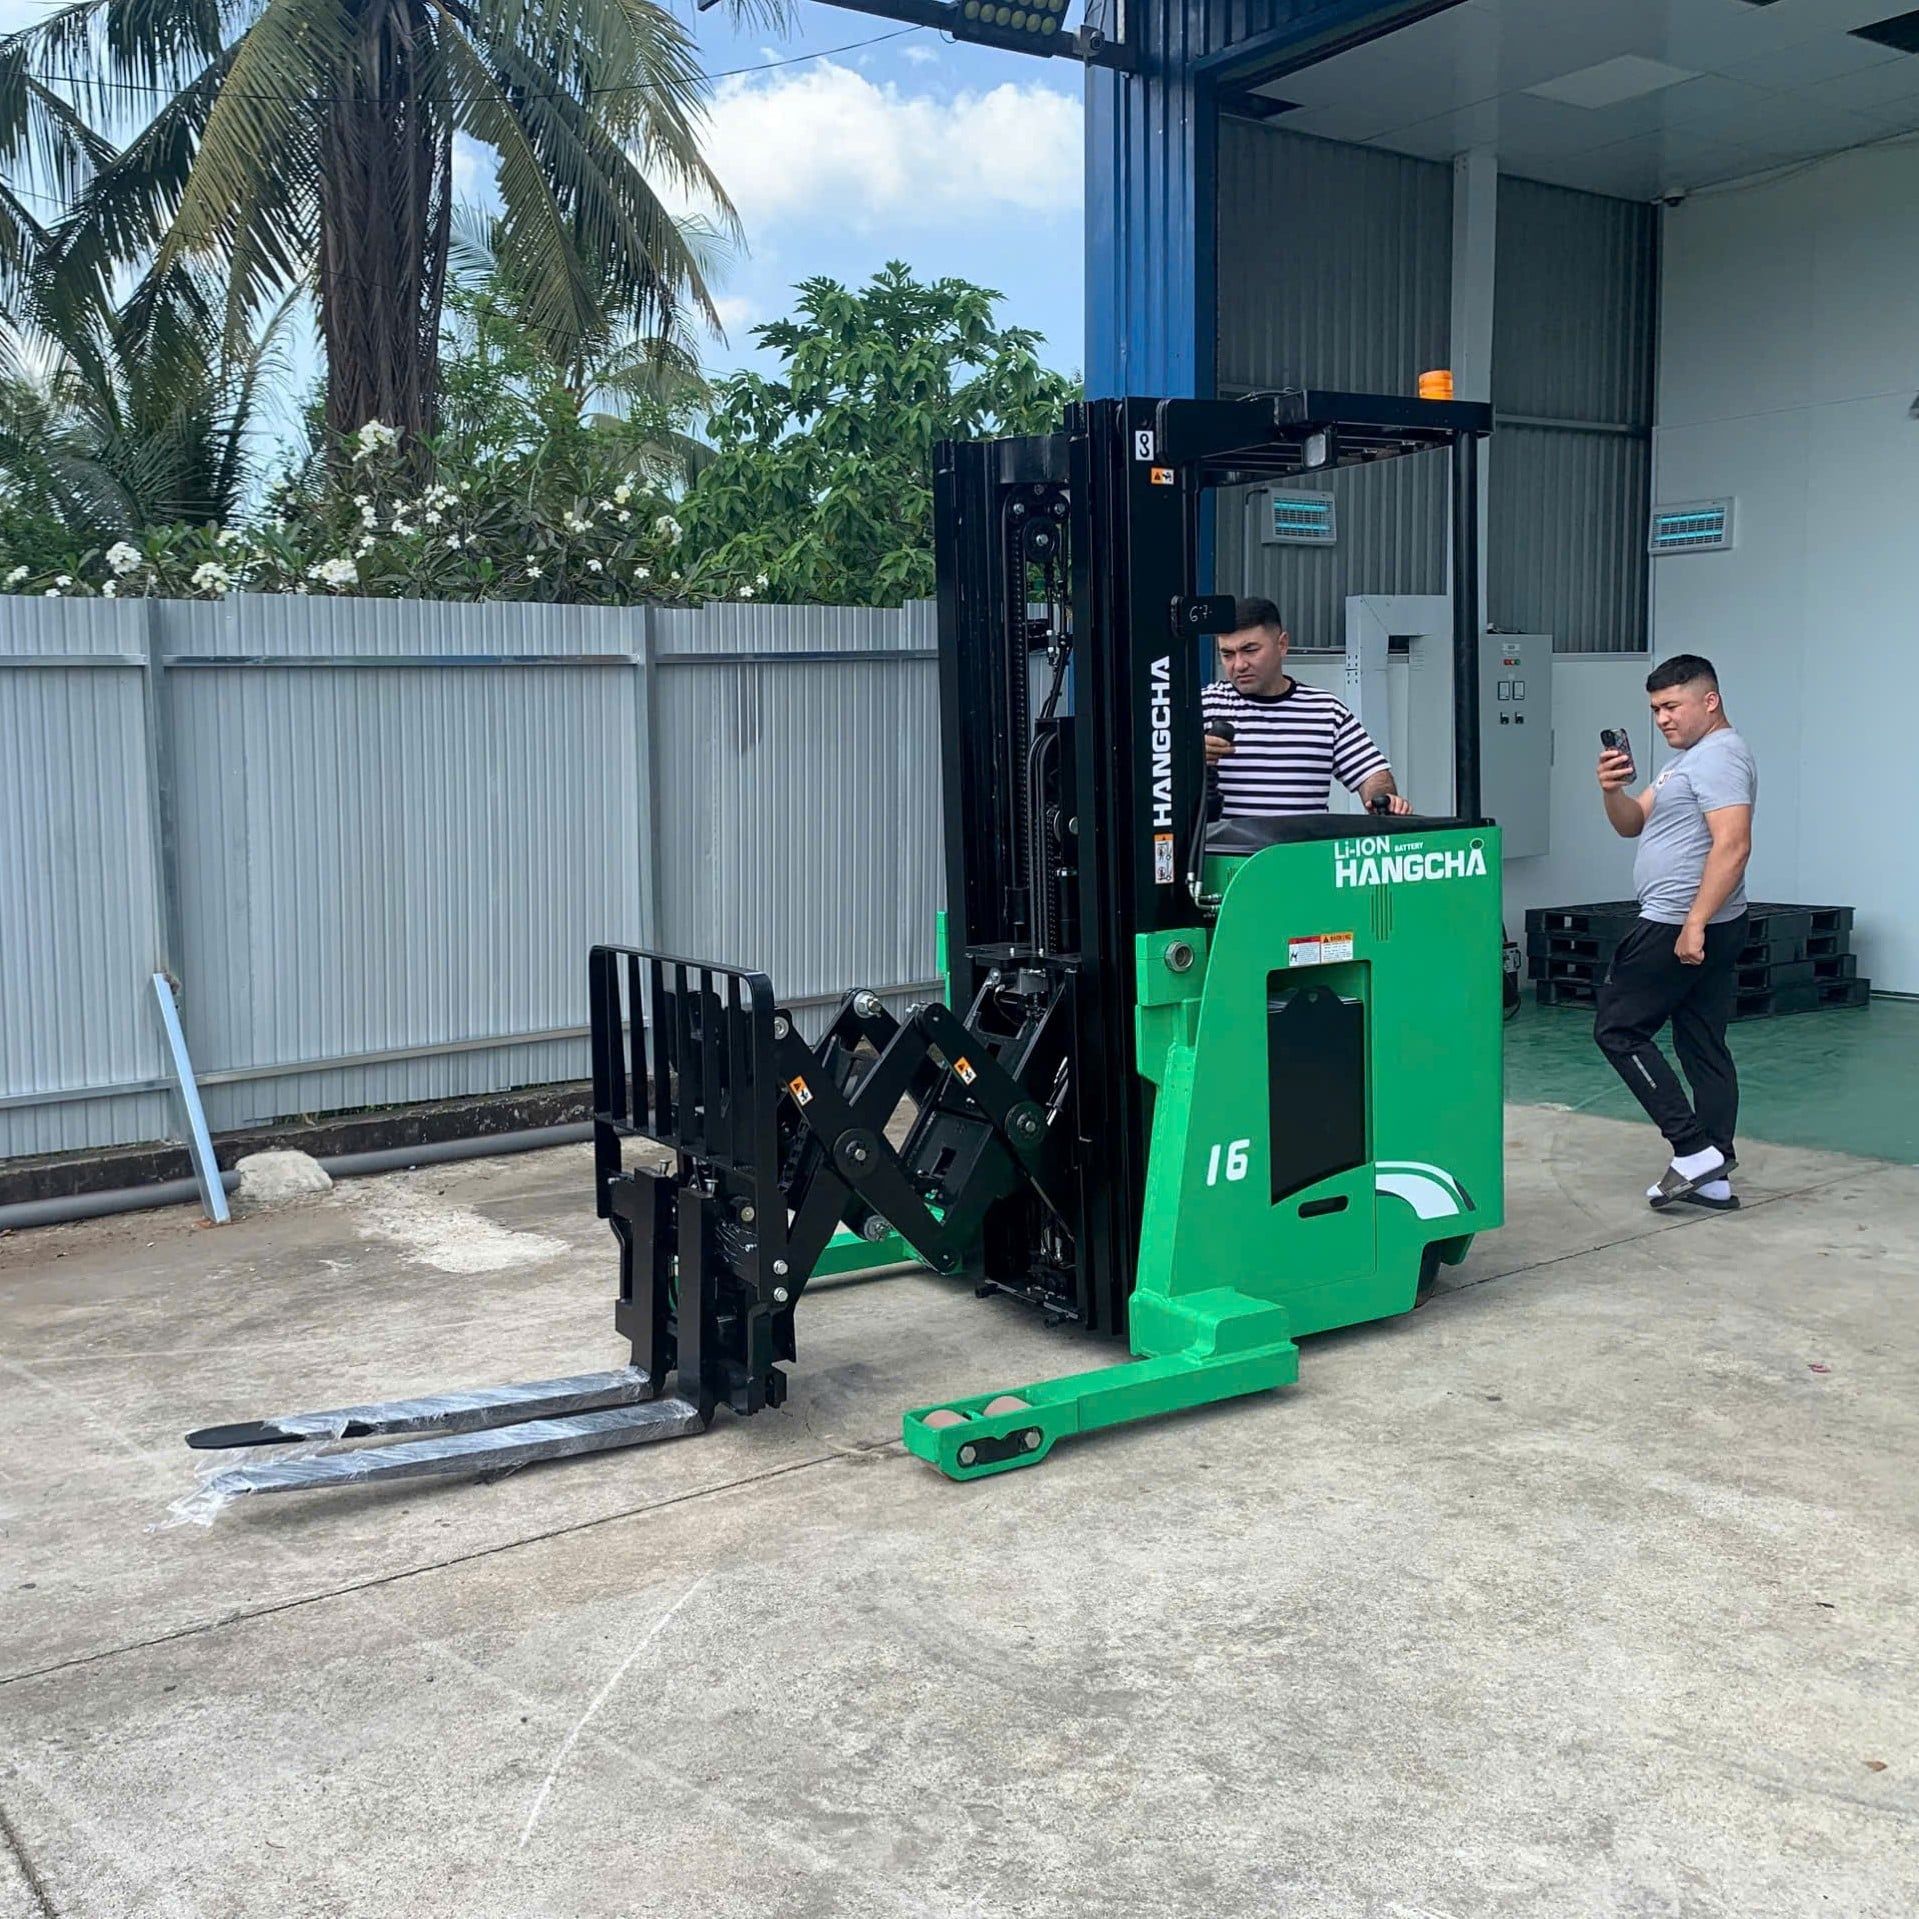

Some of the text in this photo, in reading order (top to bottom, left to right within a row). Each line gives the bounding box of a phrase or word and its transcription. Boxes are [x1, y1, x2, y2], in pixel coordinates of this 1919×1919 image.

[1150, 655, 1172, 827] HANGCHA
[1334, 835, 1424, 860] Li-ION BATTERY
[1335, 847, 1487, 888] HANGCHA
[1206, 1138, 1250, 1186] 16
